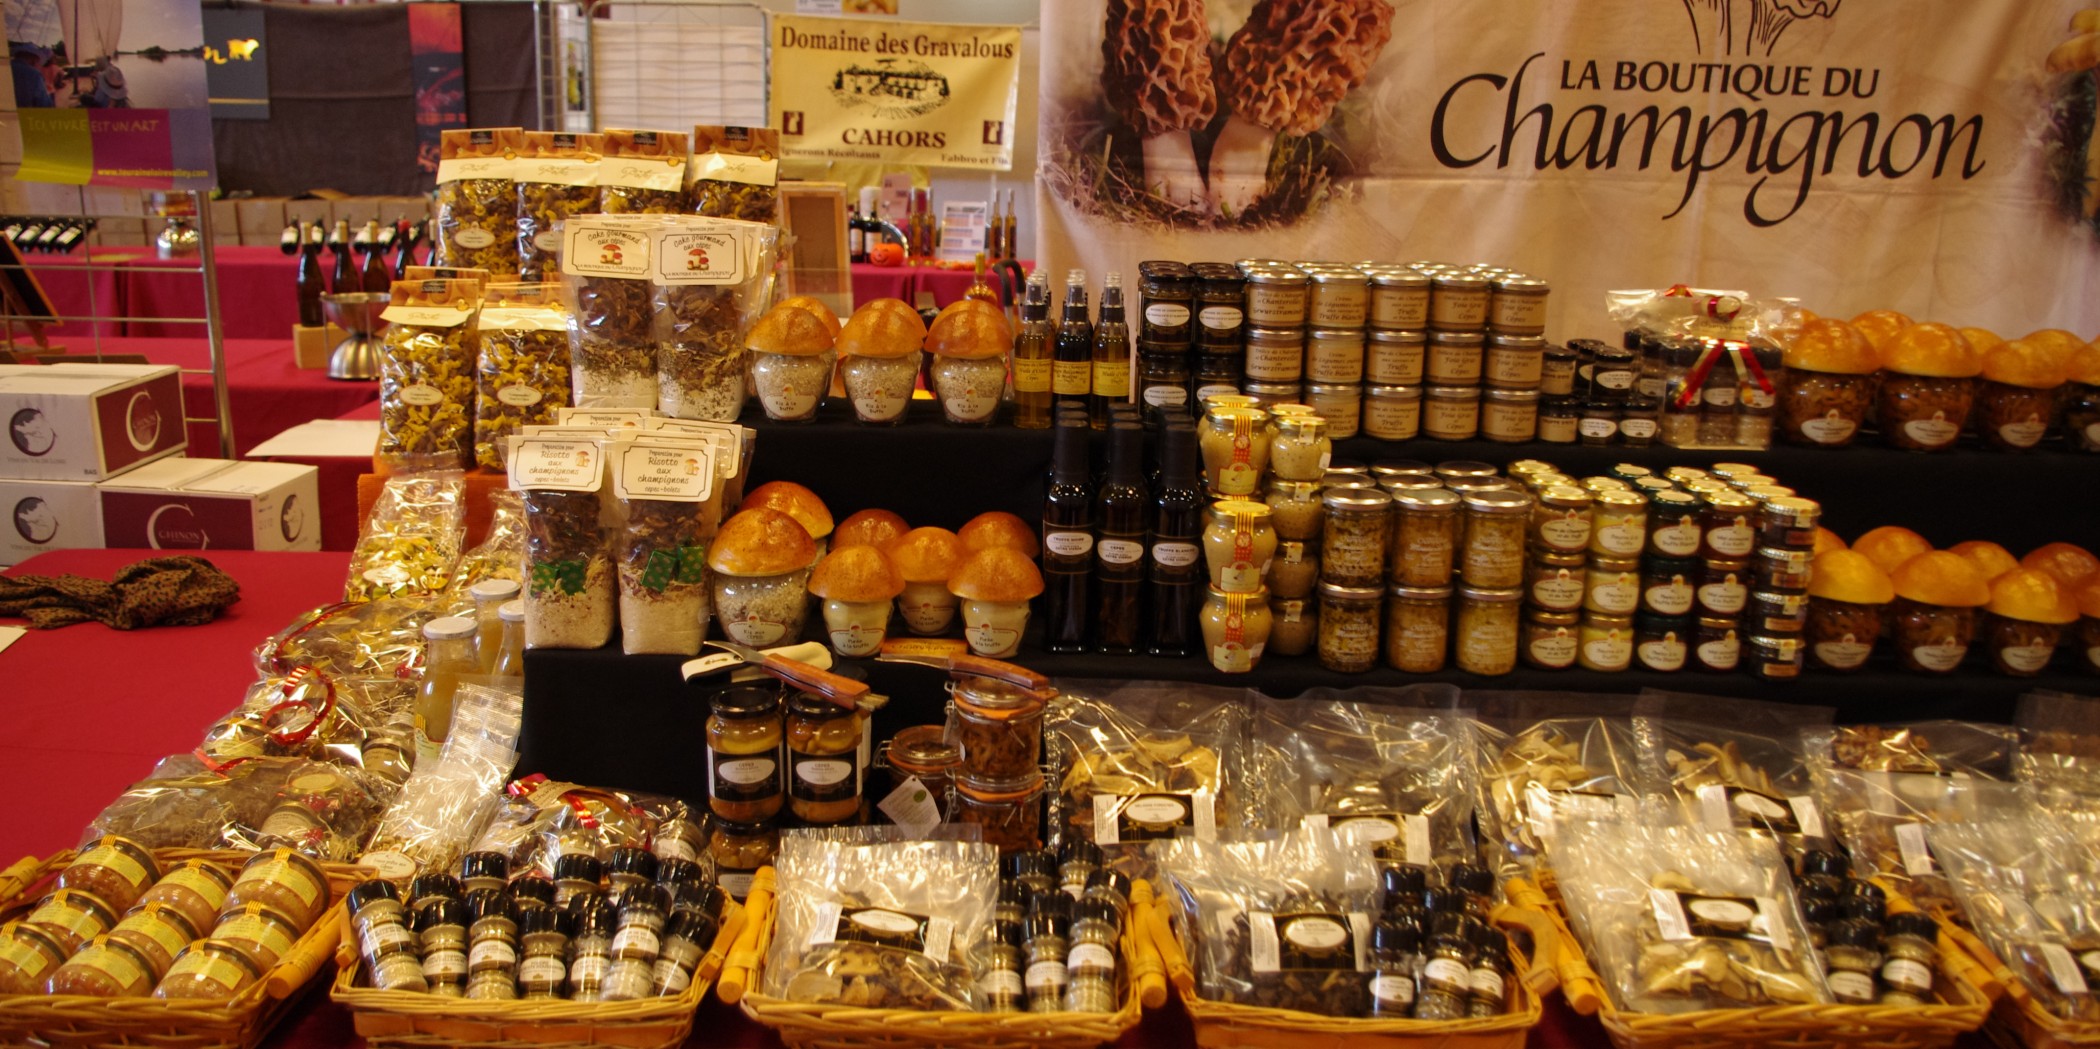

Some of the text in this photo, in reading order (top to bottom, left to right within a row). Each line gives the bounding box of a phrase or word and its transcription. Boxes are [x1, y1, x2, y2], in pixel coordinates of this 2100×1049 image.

[781, 26, 1014, 59] Domaine des Gravalous
[1560, 60, 1880, 102] LA BOUTIQUE DU
[131, 119, 159, 132] ART
[842, 128, 946, 148] CAHORS
[1430, 52, 1986, 227] Champignon
[540, 450, 570, 460] Risotto
[648, 457, 679, 467] Risotto
[158, 530, 200, 540] CHINON
